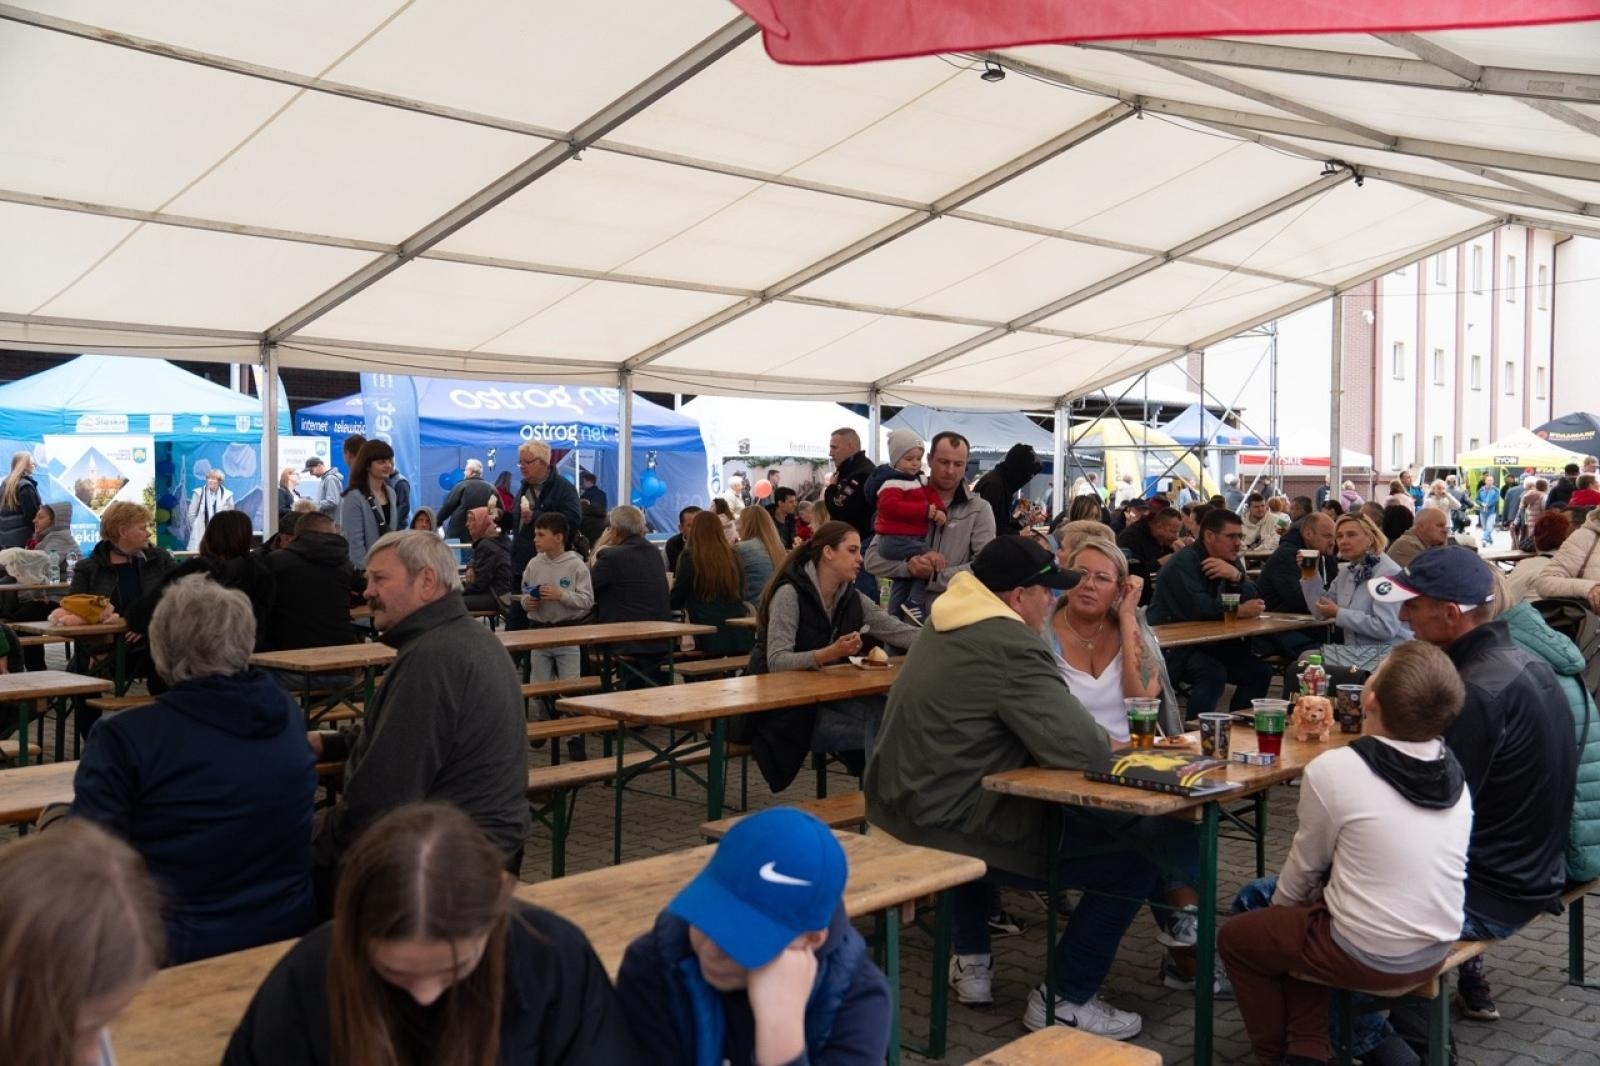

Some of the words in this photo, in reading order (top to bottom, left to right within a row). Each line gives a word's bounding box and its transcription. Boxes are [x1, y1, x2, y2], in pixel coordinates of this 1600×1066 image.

[449, 385, 584, 416] ostrog
[578, 387, 620, 407] ne
[301, 417, 329, 432] internet
[520, 423, 578, 447] ostrog
[580, 424, 609, 442] net
